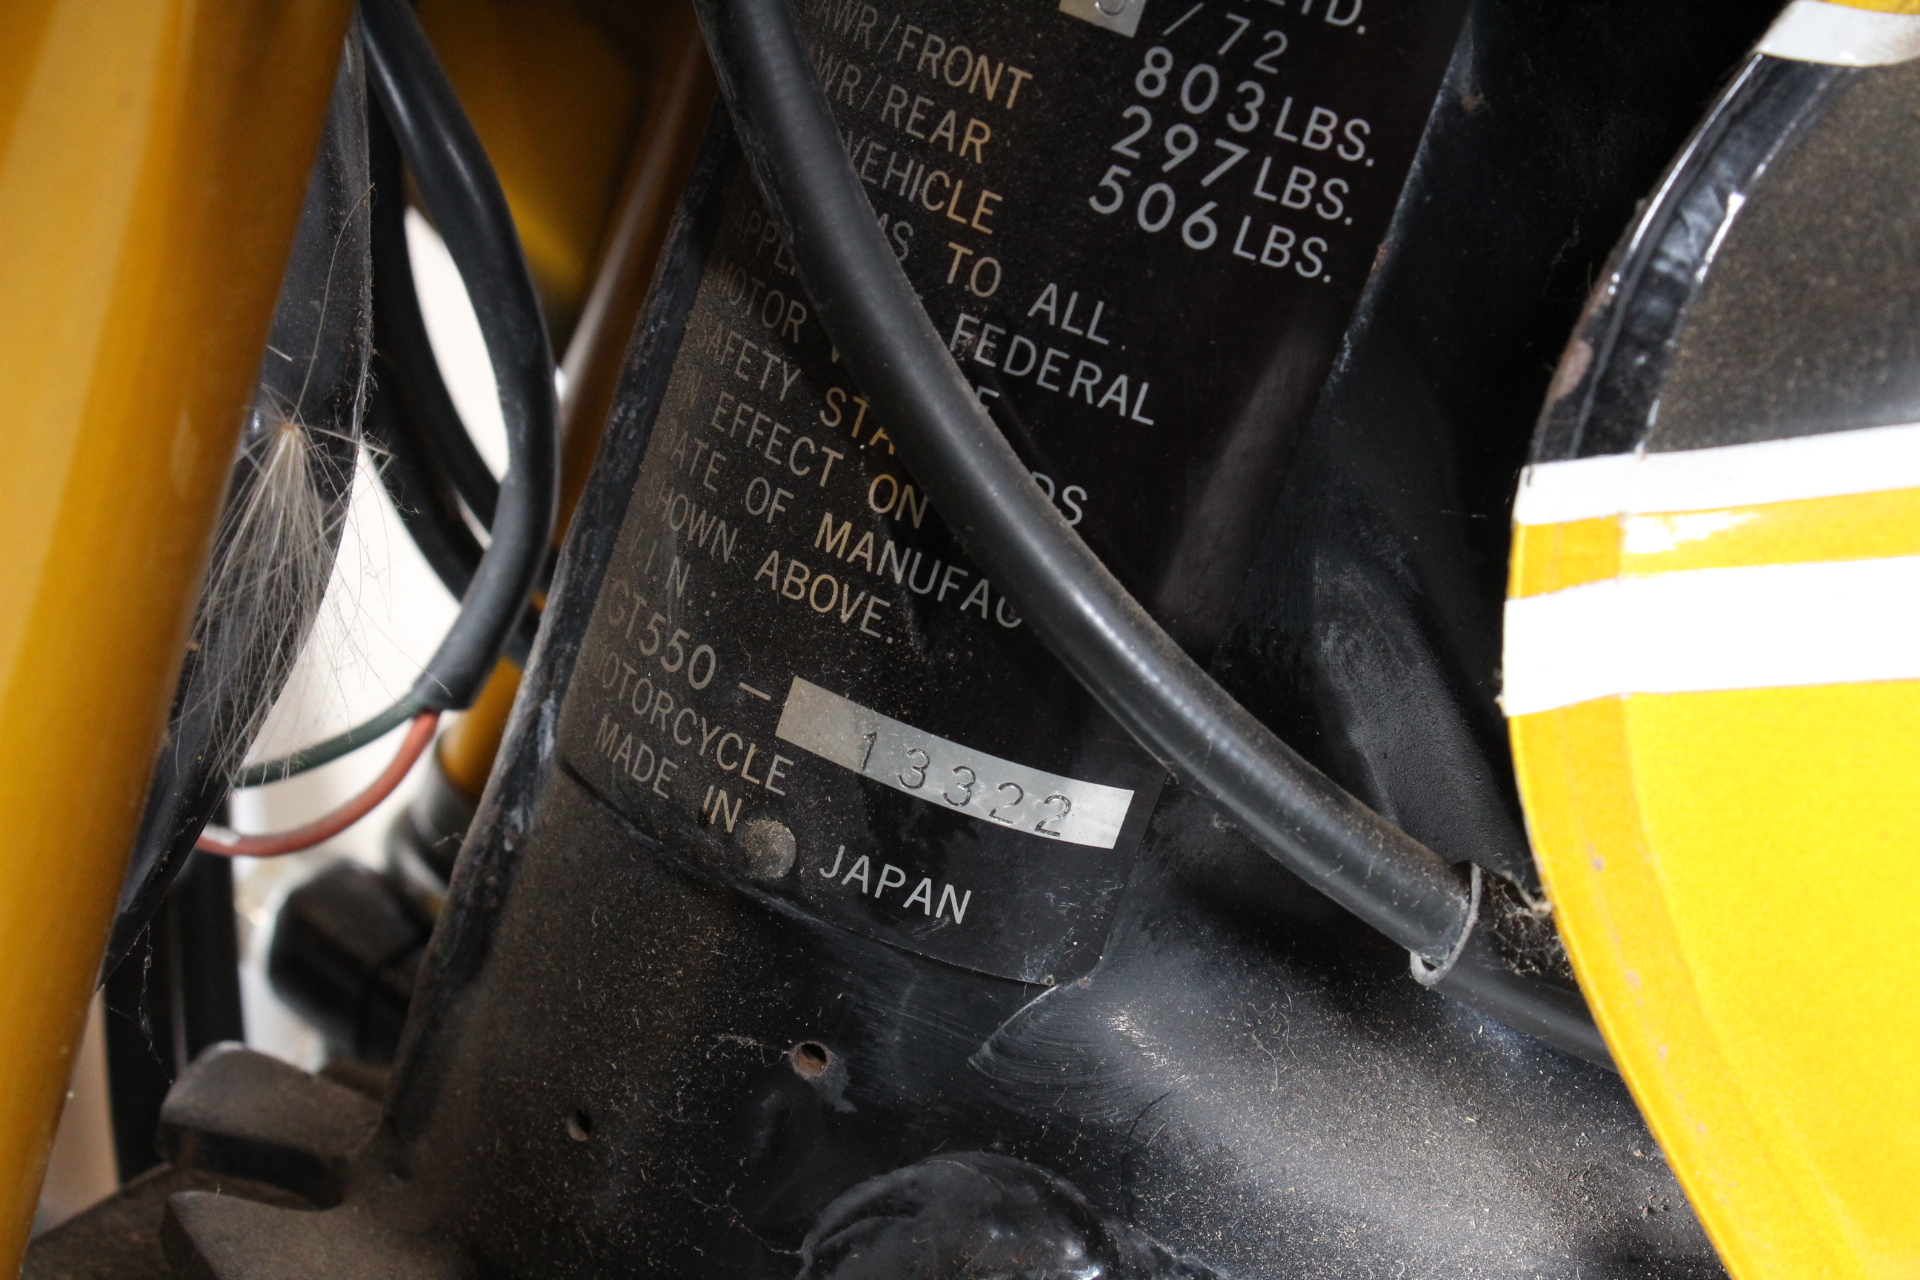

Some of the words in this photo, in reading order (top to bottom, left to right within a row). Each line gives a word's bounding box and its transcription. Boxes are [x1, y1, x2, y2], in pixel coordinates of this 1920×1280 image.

[804, 0, 1034, 110] AWR/FRONT
[1110, 104, 1251, 188] 297
[1252, 155, 1354, 227] LBS.
[809, 44, 992, 164] WR/REAR
[1088, 164, 1219, 251] 506
[1232, 215, 1332, 284] LBS.
[1134, 45, 1267, 133] 803
[1273, 95, 1375, 168] LBS.
[698, 311, 802, 402] SAFETY
[715, 256, 808, 344] MOTOR
[946, 241, 1002, 298] TO
[1026, 282, 1110, 346] ALL
[950, 312, 1155, 426] FEDERAL
[661, 418, 727, 493] DATE
[745, 476, 795, 525] OF
[814, 511, 1023, 629] MANUFAC
[711, 390, 845, 488] EFFECT
[867, 473, 930, 530] ON
[645, 472, 739, 564] SHOWN
[754, 550, 894, 645] ABOVE.
[608, 578, 717, 691] GT550
[859, 730, 1073, 838] 13322
[595, 713, 679, 799] MADE
[702, 785, 743, 834] IN
[819, 845, 972, 925] JAPAN
